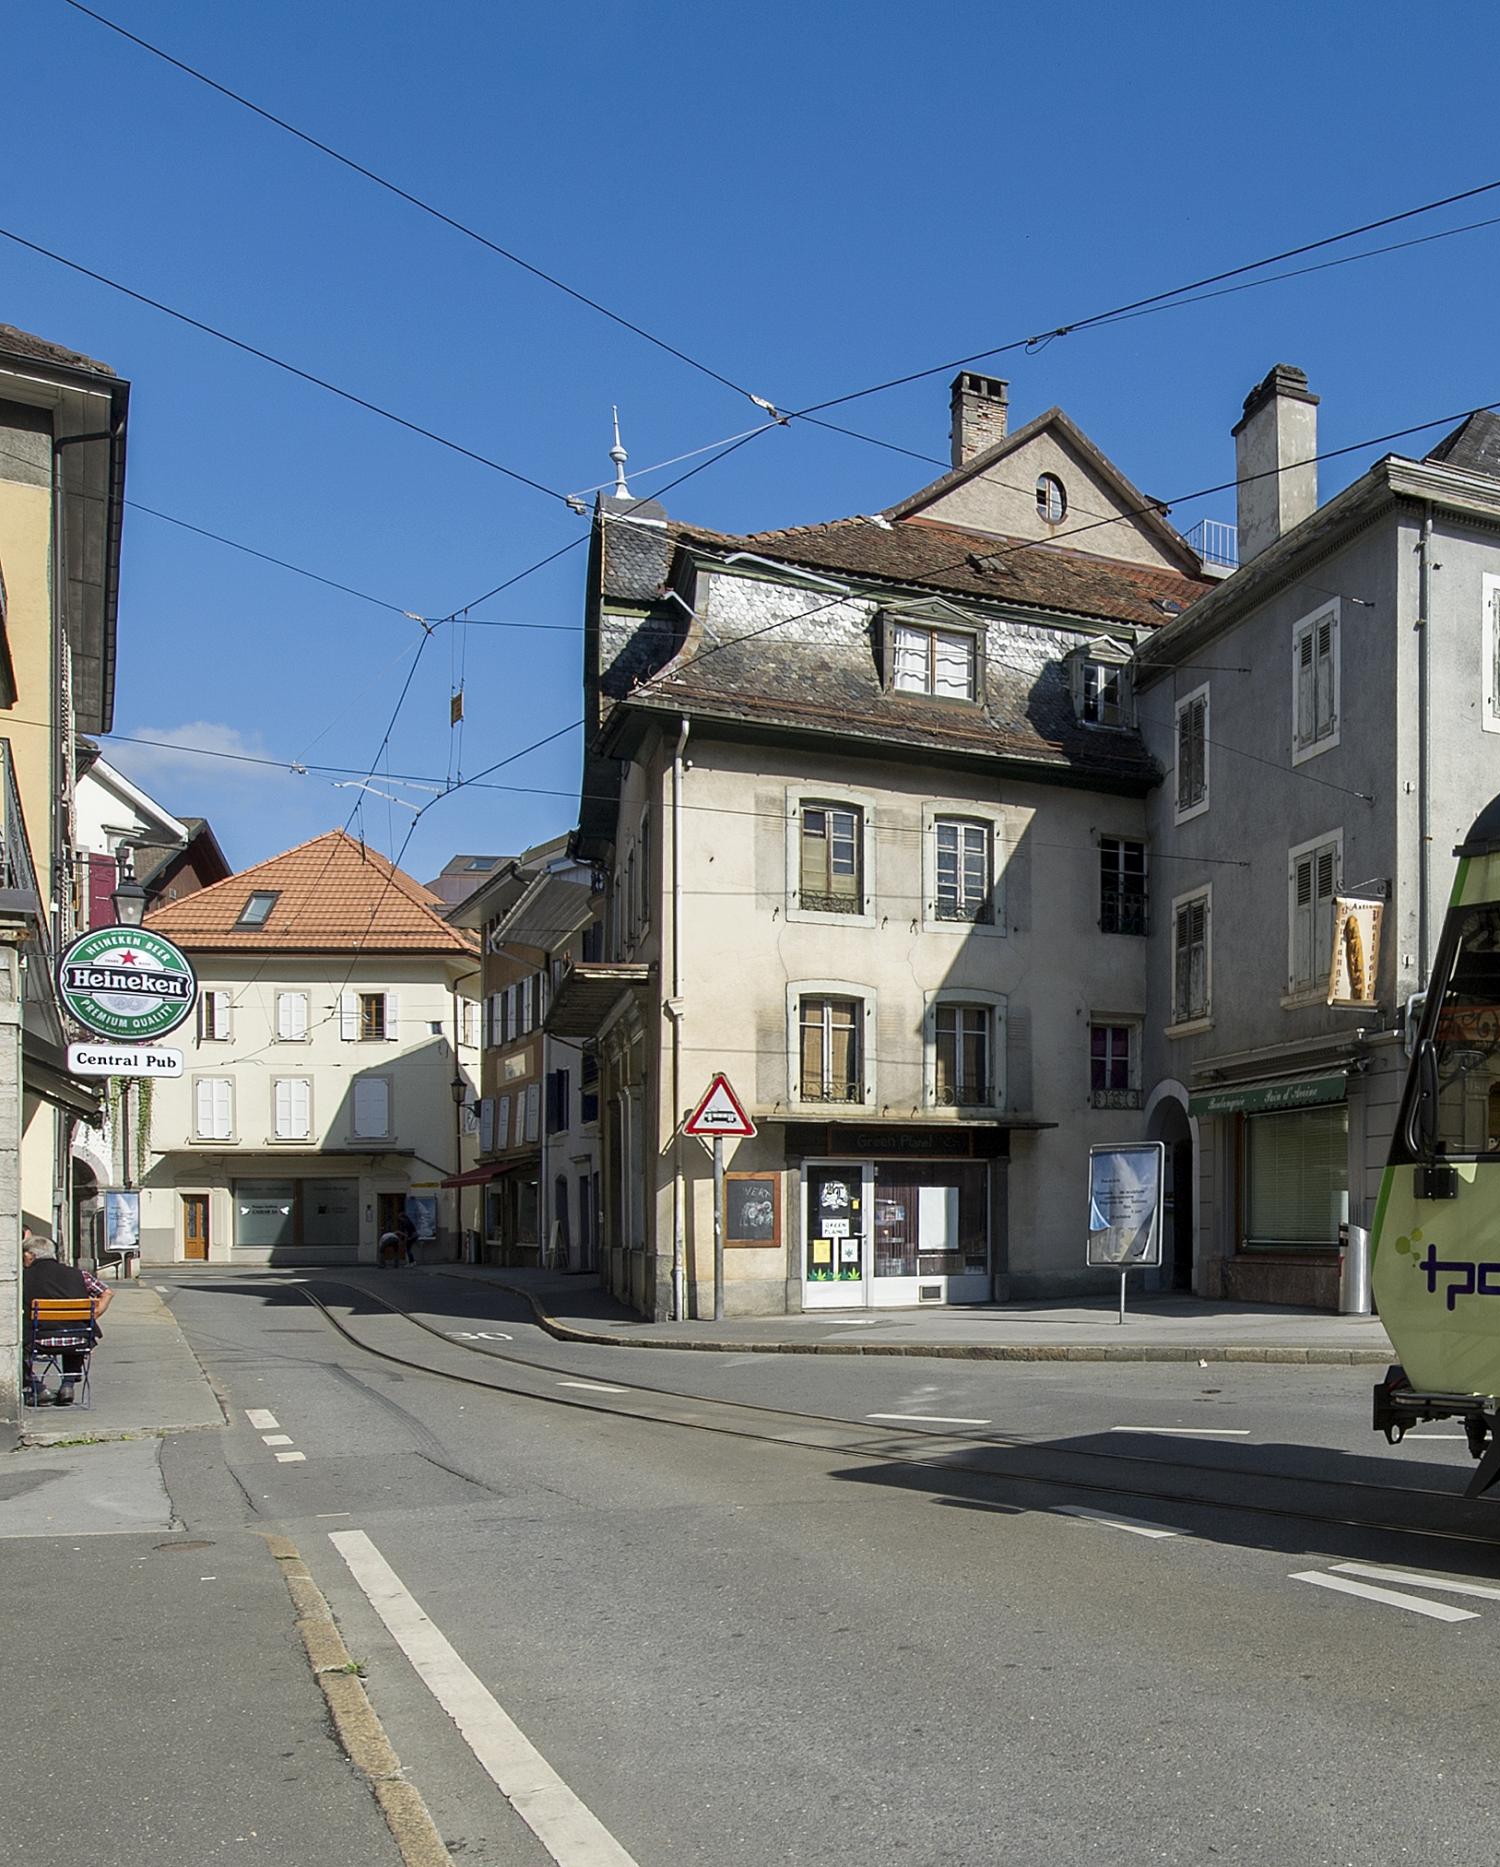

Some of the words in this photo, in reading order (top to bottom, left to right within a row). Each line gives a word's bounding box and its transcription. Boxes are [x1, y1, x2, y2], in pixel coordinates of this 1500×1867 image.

[85, 936, 141, 956] HEINEKEN
[145, 942, 171, 962] BEER
[73, 969, 183, 995] Heineken
[80, 999, 128, 1028] PREMIUM
[132, 1004, 173, 1028] QUALITY
[76, 1052, 139, 1067] Central
[146, 1055, 177, 1068] Pub
[856, 1134, 896, 1148] Green
